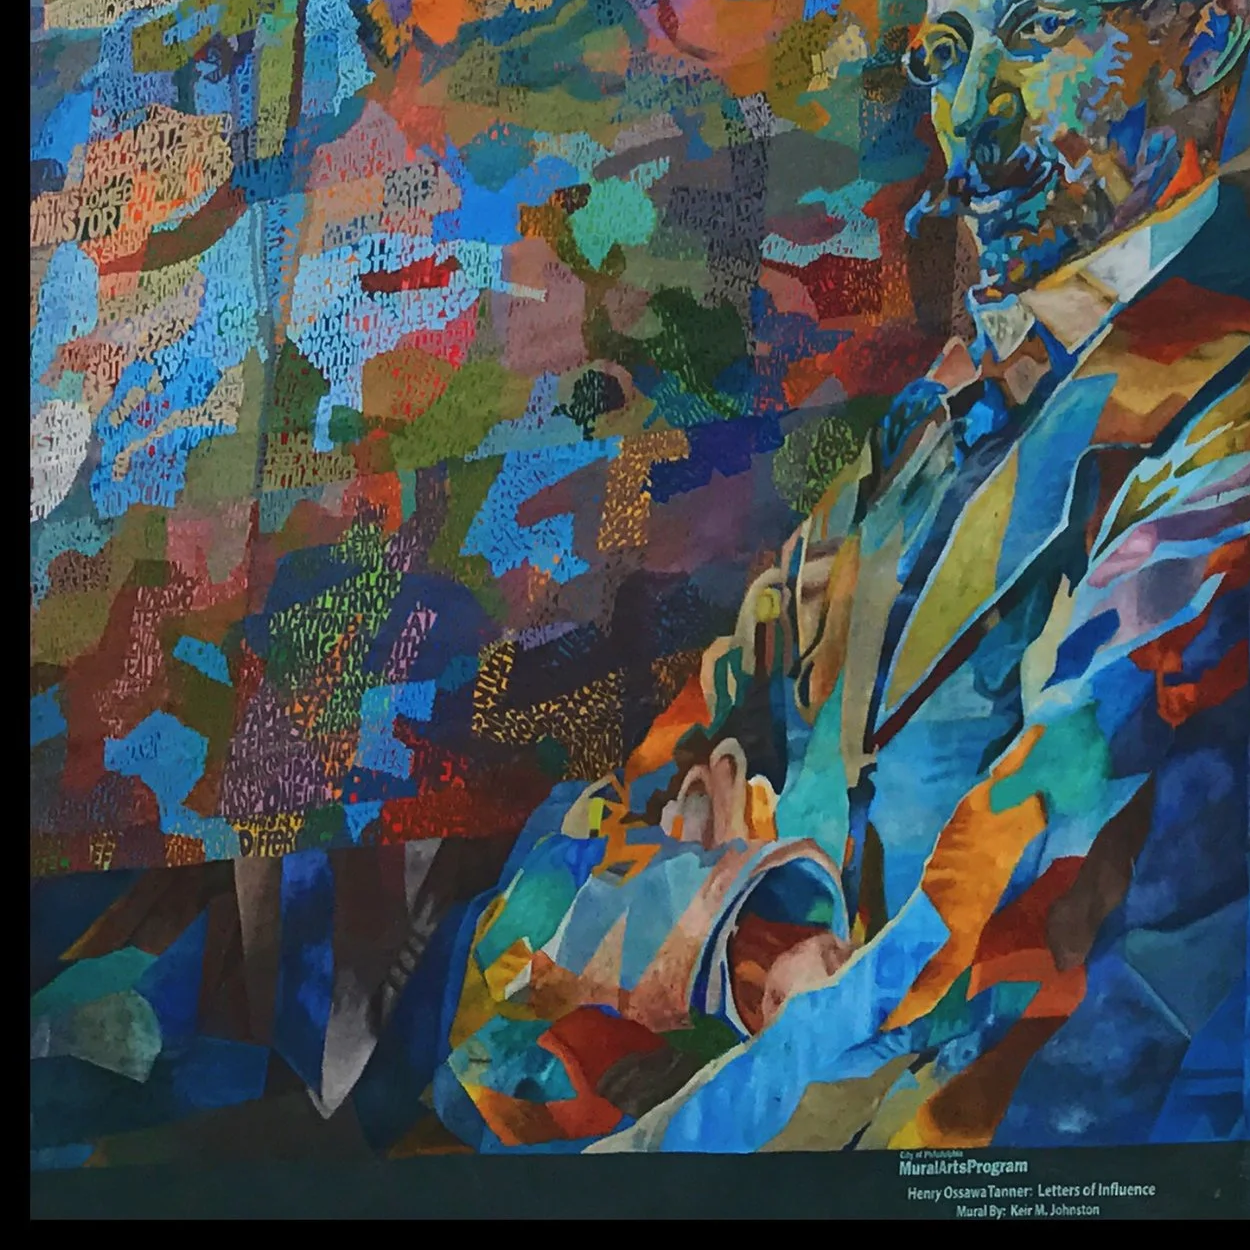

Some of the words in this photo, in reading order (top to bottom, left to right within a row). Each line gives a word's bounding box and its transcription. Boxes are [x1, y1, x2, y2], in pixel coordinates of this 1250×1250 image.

[907, 1187, 941, 1202] Henry
[943, 1186, 987, 1199] Ossawa
[987, 1184, 1033, 1198] Tanner:
[1037, 1183, 1080, 1197] Letters
[1082, 1182, 1096, 1196] of
[1098, 1181, 1156, 1196] Influence
[956, 1205, 987, 1218] Mural
[989, 1204, 1006, 1220] By:
[1010, 1203, 1033, 1217] Keir
[1034, 1204, 1048, 1217] M.
[1050, 1203, 1100, 1217] Johnston
